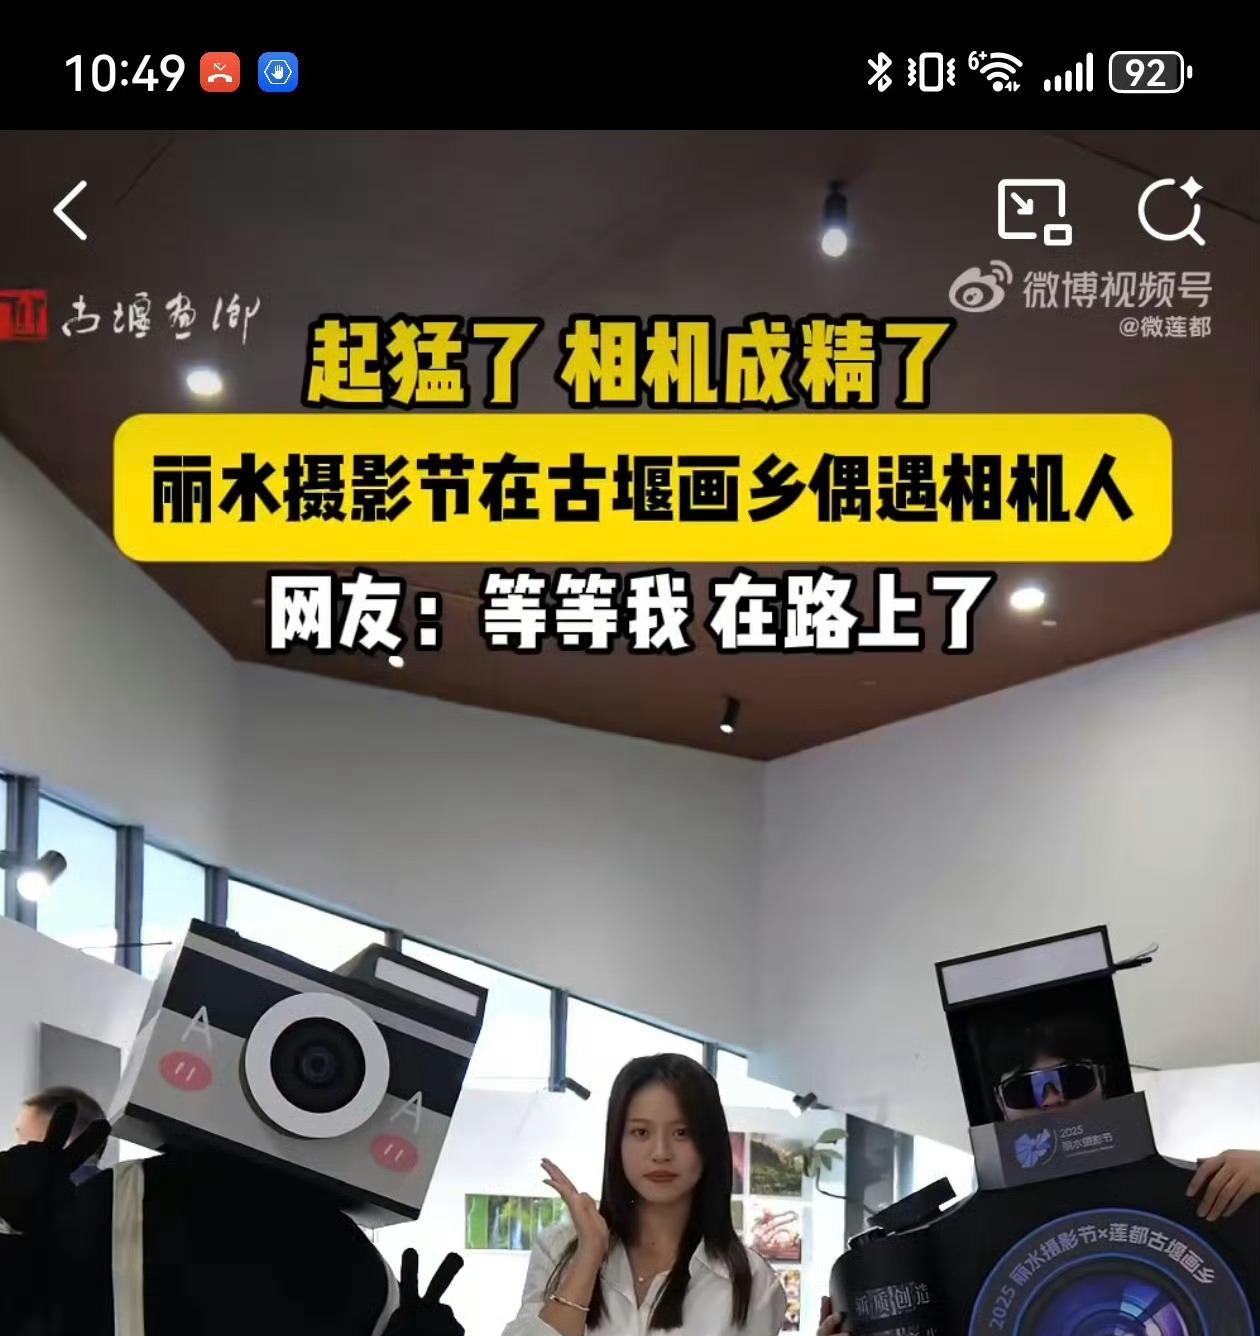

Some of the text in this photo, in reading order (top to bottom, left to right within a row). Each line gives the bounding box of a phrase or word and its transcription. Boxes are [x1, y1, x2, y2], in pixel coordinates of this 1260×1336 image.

[1060, 1124, 1084, 1139] 2025
[1061, 1132, 1113, 1151] 丽水摄影节
[988, 1285, 1016, 1330] 2025
